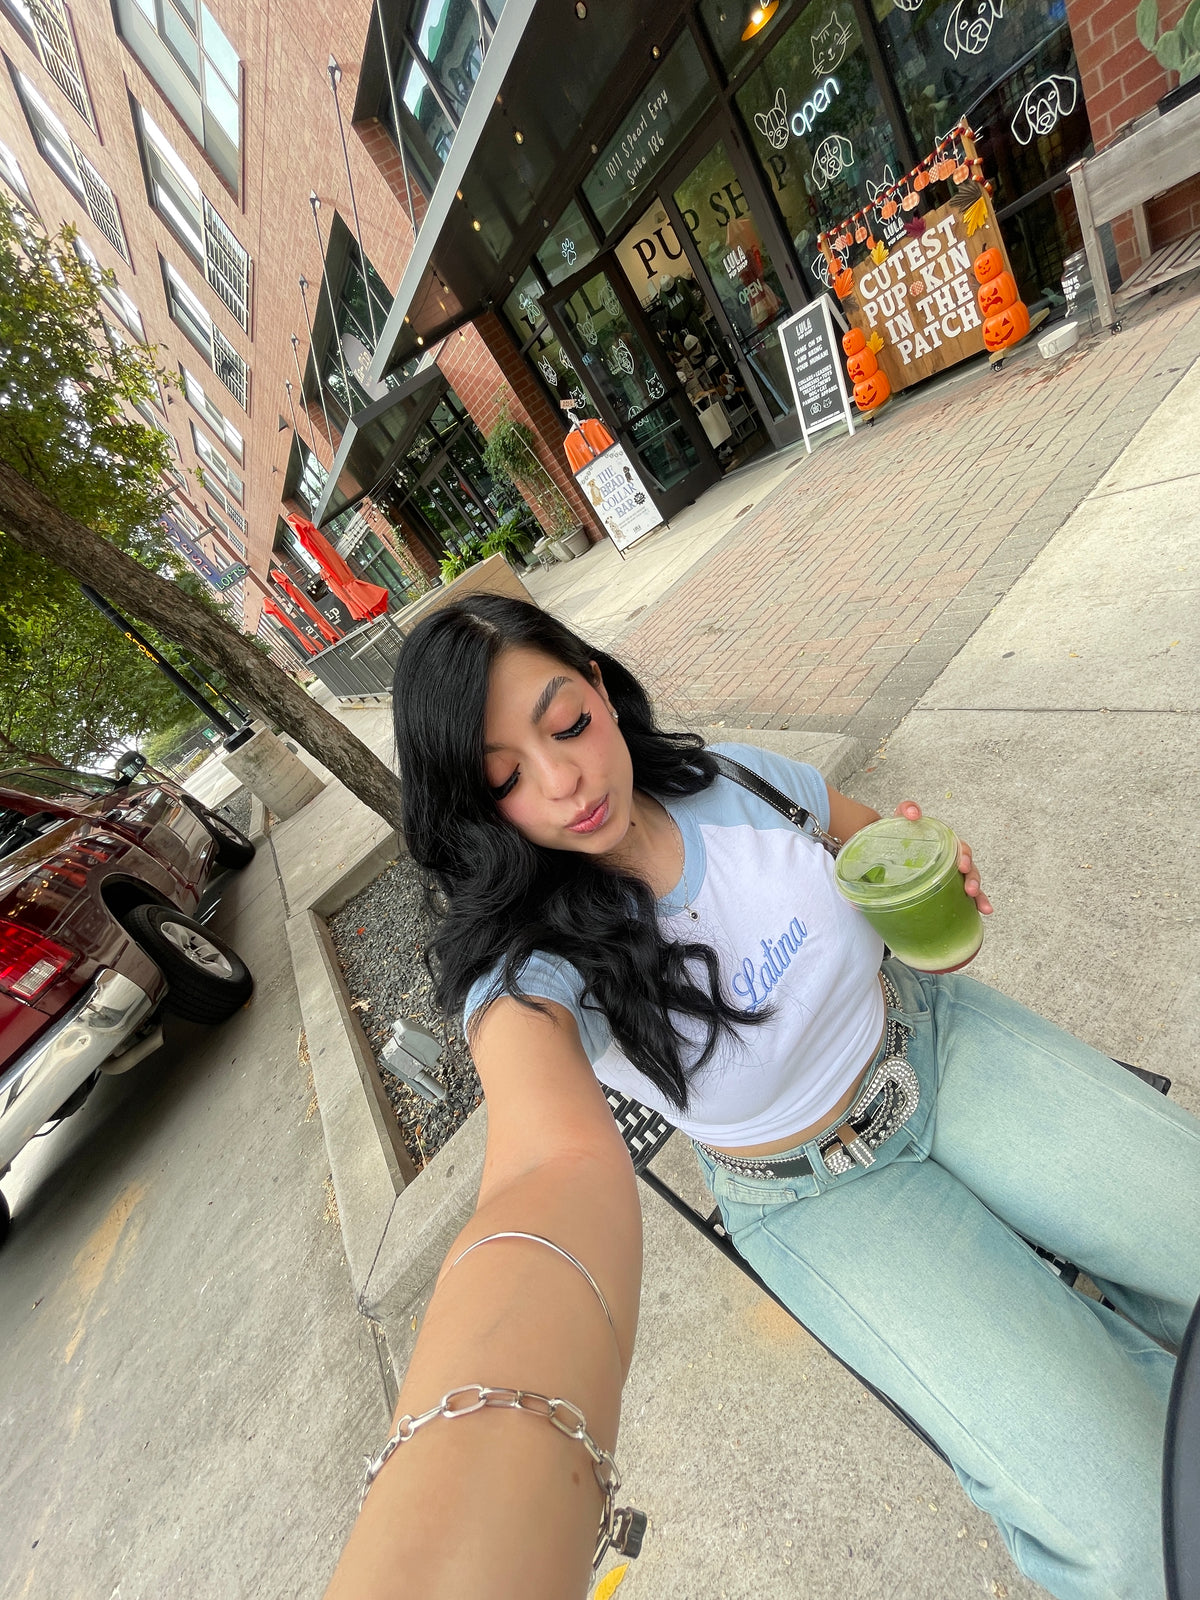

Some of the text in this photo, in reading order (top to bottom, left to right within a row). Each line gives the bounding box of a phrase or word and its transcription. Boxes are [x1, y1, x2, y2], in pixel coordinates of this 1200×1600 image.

[791, 76, 841, 137] open
[606, 152, 623, 180] 1011
[647, 90, 669, 120] Expy
[626, 131, 665, 185] Suite 186
[708, 153, 788, 229] SHP
[883, 217, 905, 240] LULA
[722, 245, 746, 274] LULA
[858, 214, 957, 301] CUTEST
[738, 278, 764, 305] OPEN
[862, 241, 975, 329] PUP KIN
[884, 273, 974, 344] IN THE
[795, 317, 812, 337] LULA
[895, 302, 982, 365] PATCH
[807, 339, 816, 348] ON
[597, 465, 616, 484] THE
[600, 474, 626, 498] BEAD
[601, 482, 637, 512] COLLAR
[615, 498, 637, 518] BAR
[215, 564, 247, 591] LOFTS
[124, 631, 160, 664] P1041
[732, 916, 808, 1013] Latina
